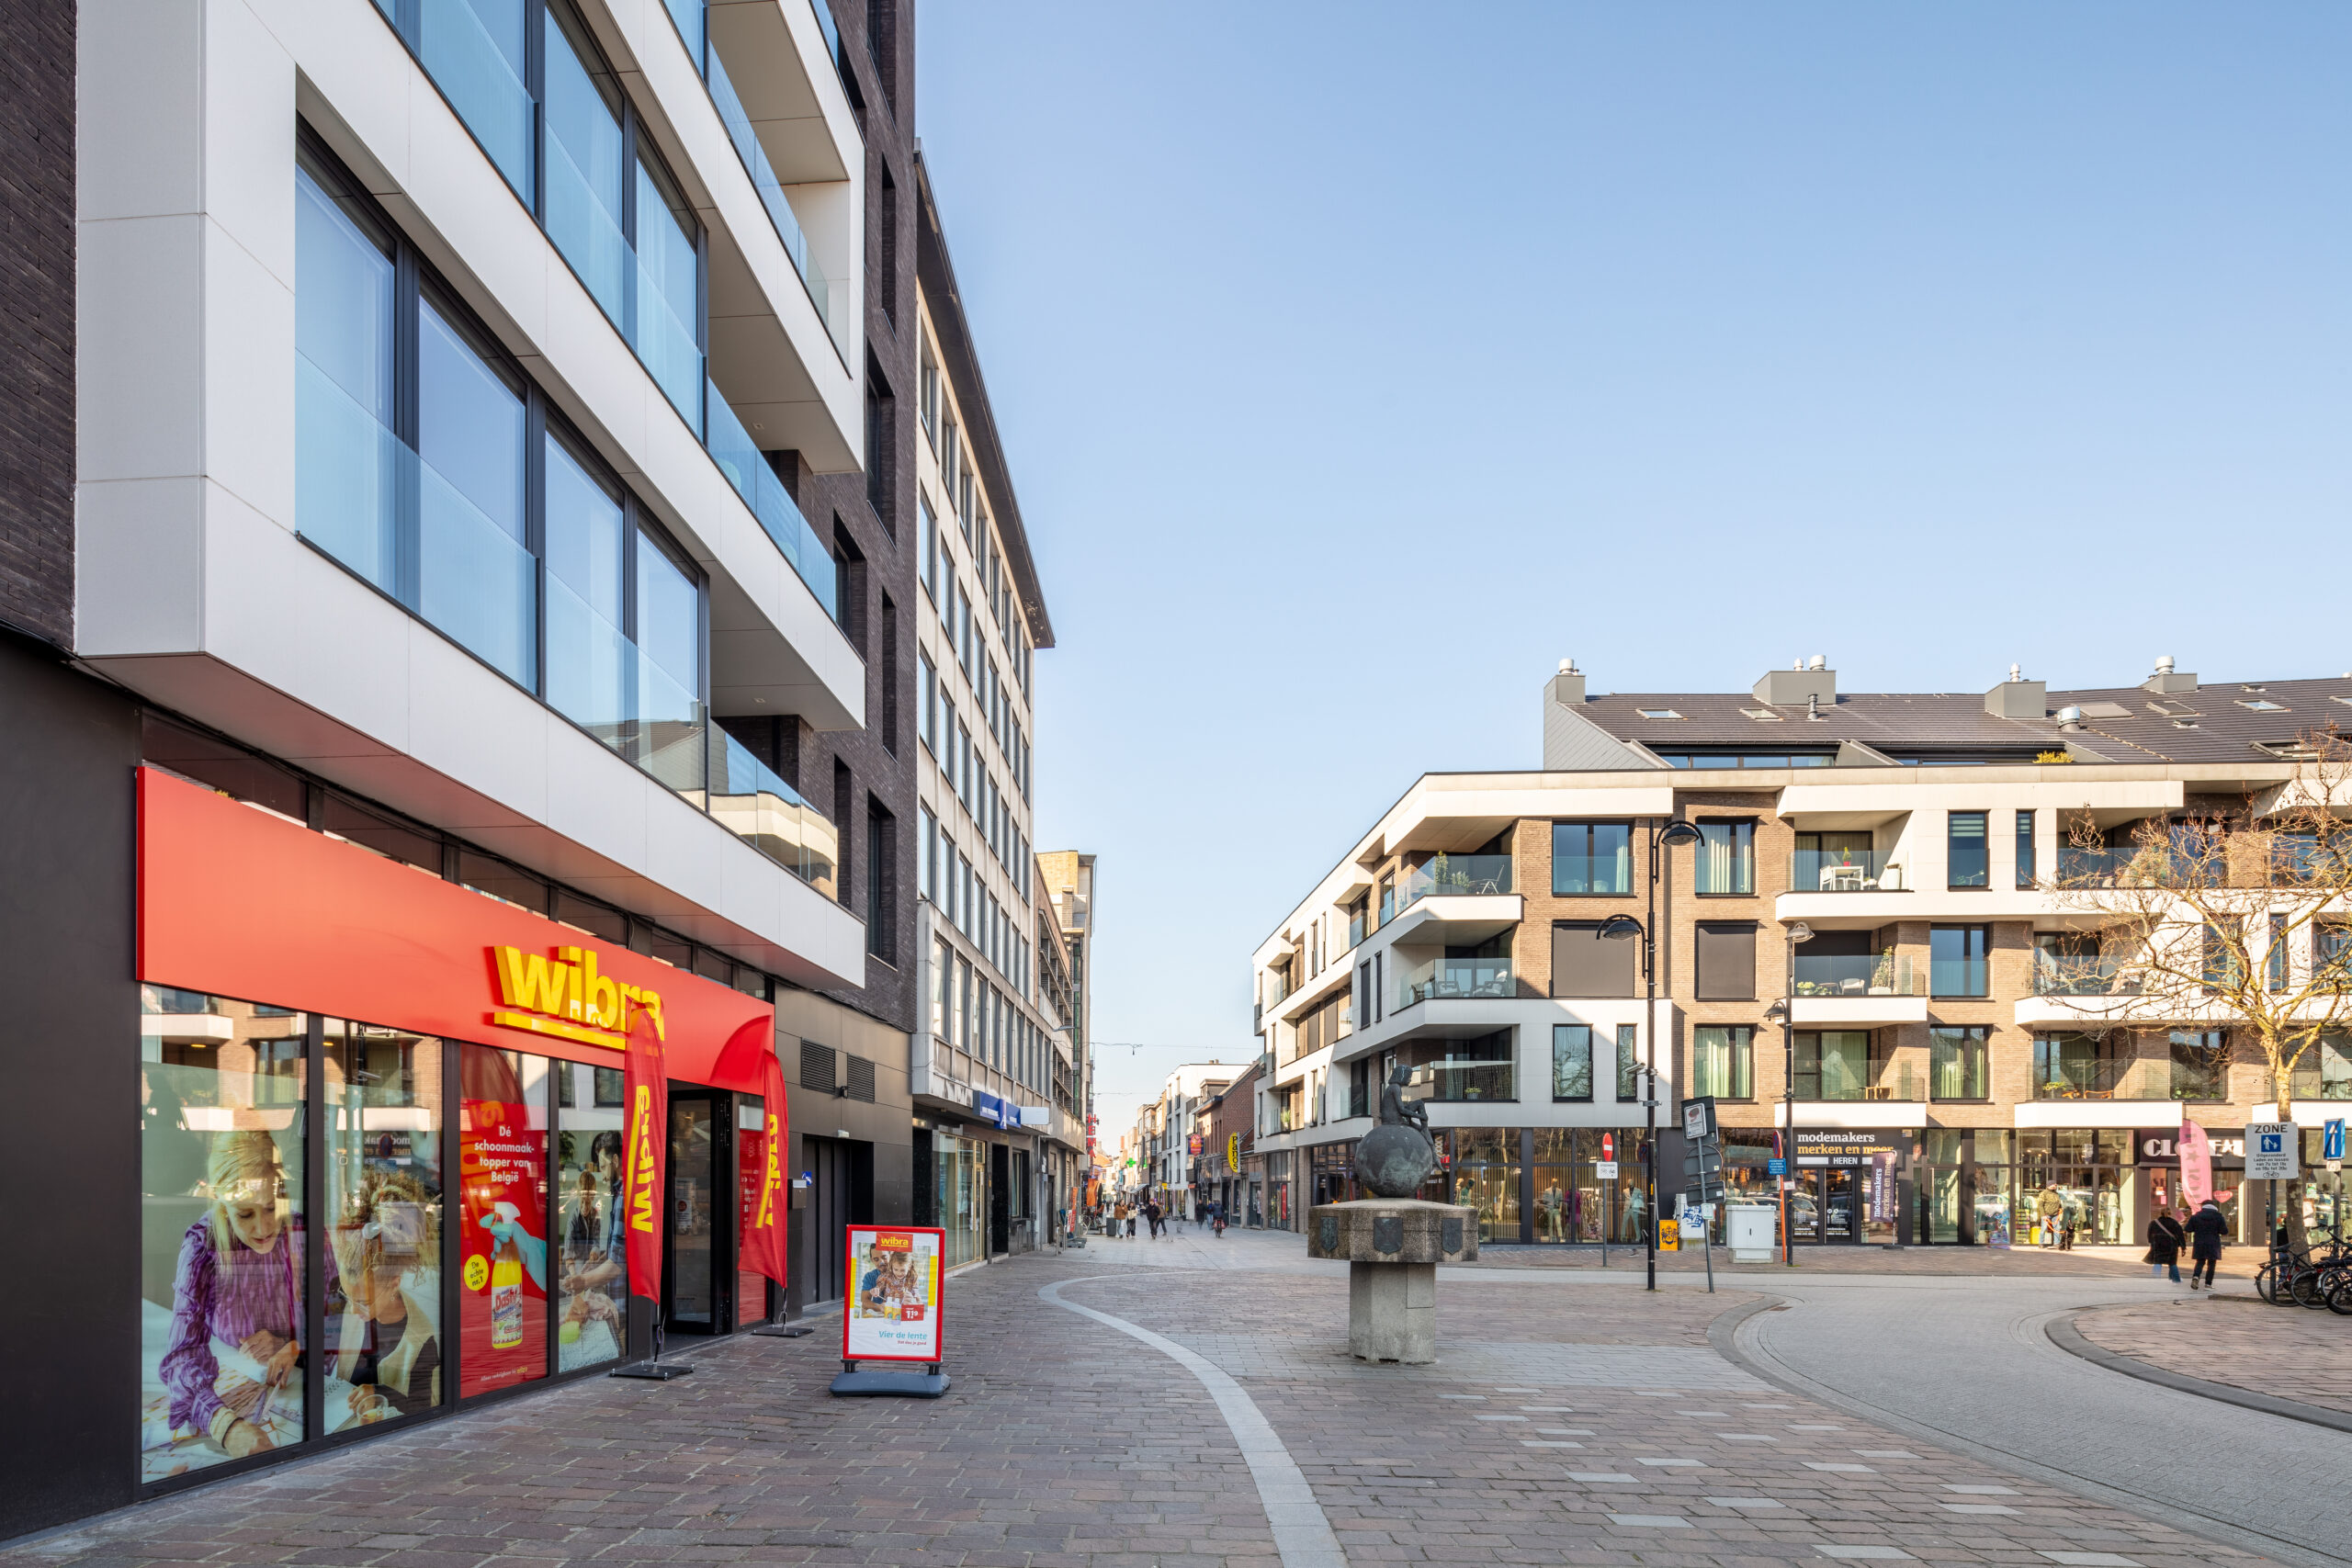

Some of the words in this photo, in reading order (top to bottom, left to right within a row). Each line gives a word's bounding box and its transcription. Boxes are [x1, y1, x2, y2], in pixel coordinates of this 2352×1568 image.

[499, 1125, 512, 1137] Dé
[2255, 1124, 2288, 1134] ZONE
[1088, 1113, 1097, 1158] HEMA
[1797, 1132, 1875, 1143] modemakers
[474, 1139, 535, 1153] schoonmaak-
[1797, 1144, 1843, 1155] merken
[1845, 1146, 1860, 1155] en
[480, 1156, 511, 1169] topper
[513, 1159, 529, 1168] van
[491, 1170, 519, 1185] België
[1873, 1168, 1883, 1217] modemakers
[881, 1237, 909, 1247] wibra
[879, 1330, 895, 1338] Vier
[908, 1332, 927, 1340] lente
